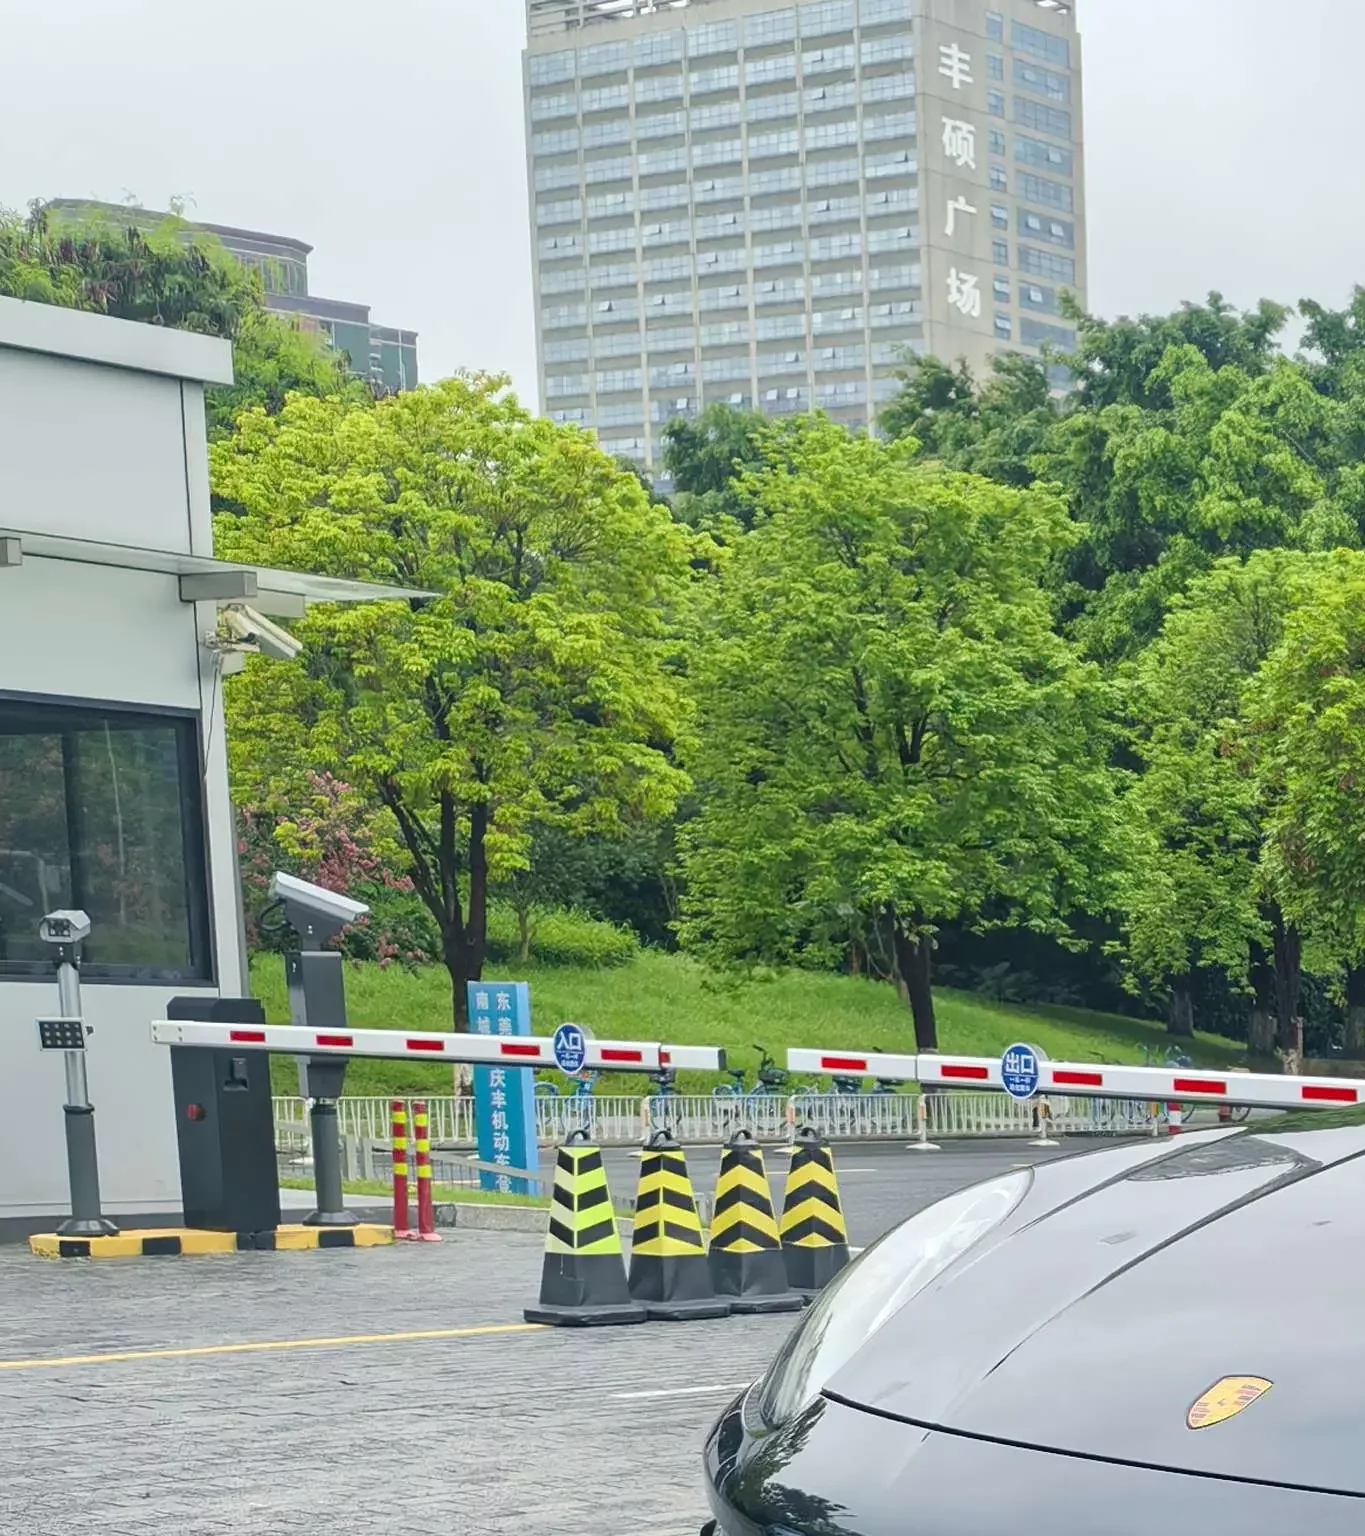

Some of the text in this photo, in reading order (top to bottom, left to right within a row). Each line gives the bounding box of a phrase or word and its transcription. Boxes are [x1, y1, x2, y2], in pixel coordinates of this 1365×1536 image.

[938, 44, 981, 317] 丰硕广场
[557, 1031, 582, 1050] 入口
[1005, 1052, 1034, 1074] 出口
